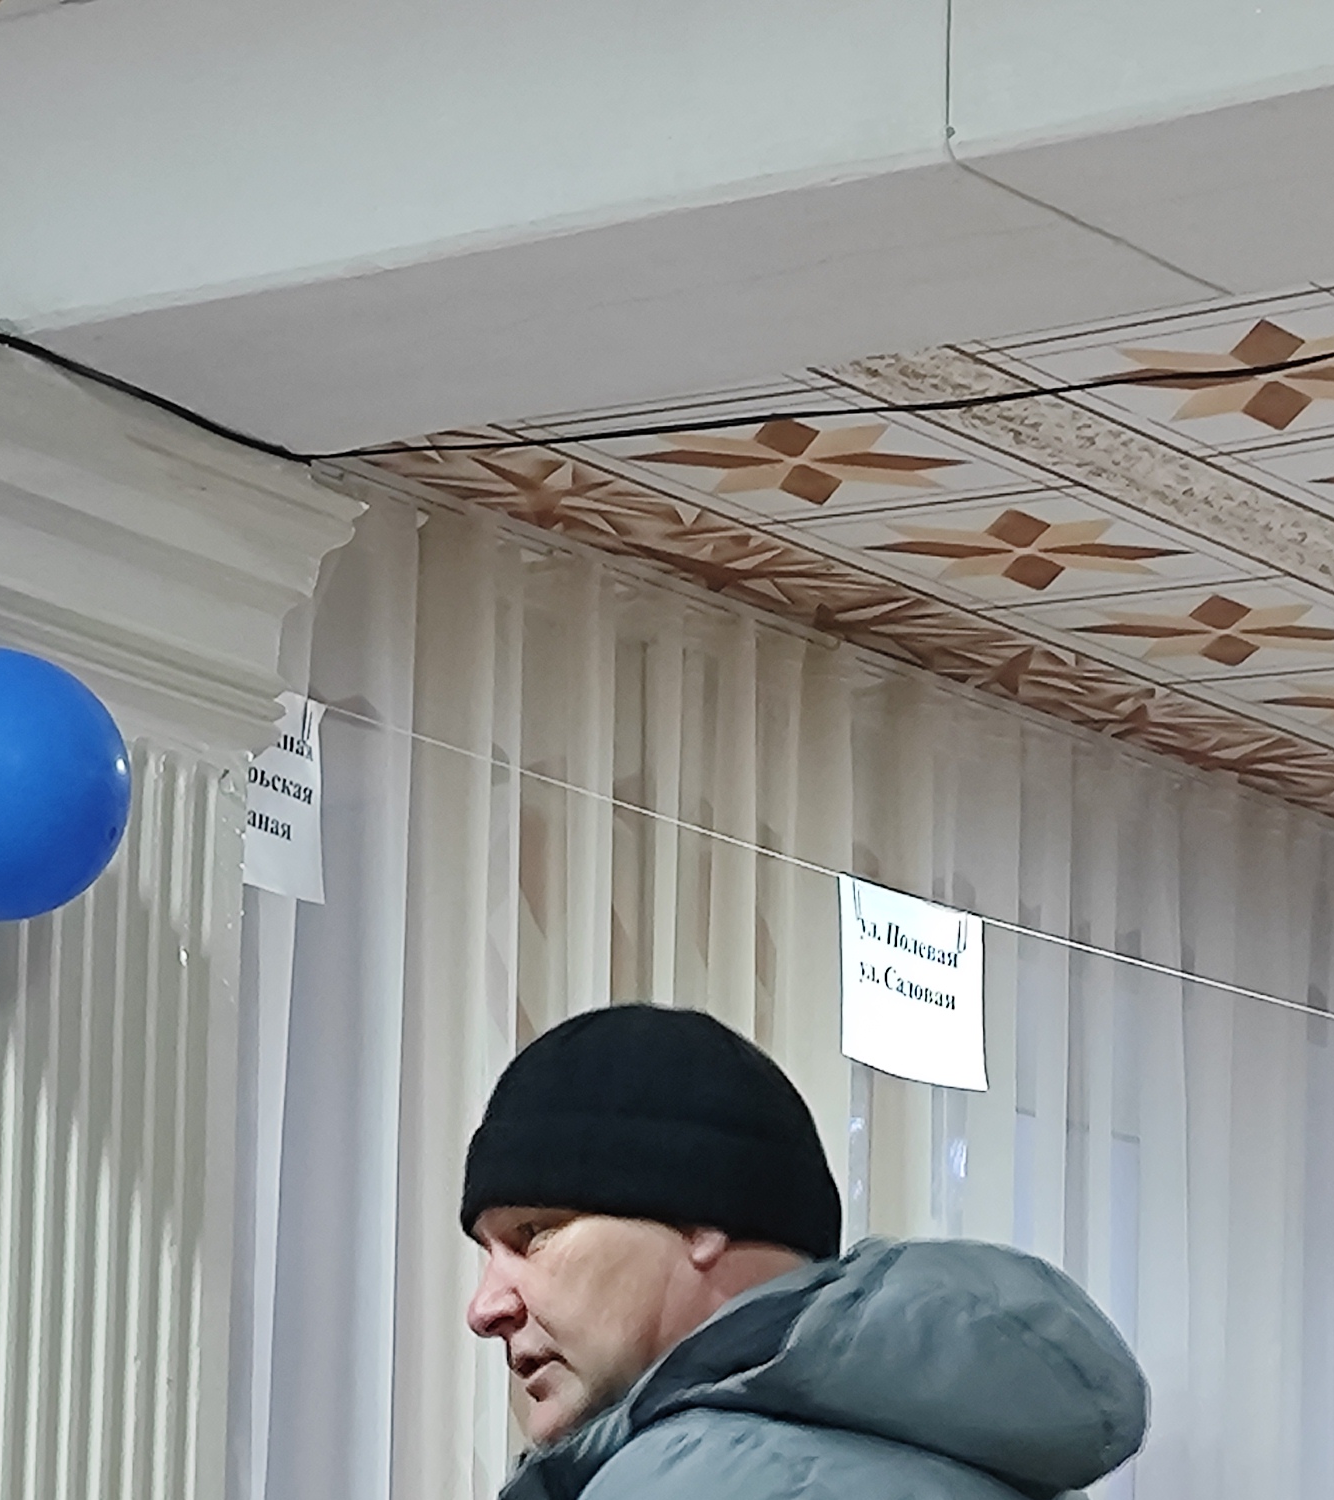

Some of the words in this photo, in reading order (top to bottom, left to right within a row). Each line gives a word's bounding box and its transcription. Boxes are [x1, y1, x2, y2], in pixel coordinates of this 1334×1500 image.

[276, 733, 313, 761] ная
[886, 921, 958, 968] Полевая
[883, 965, 955, 1010] Садовая
